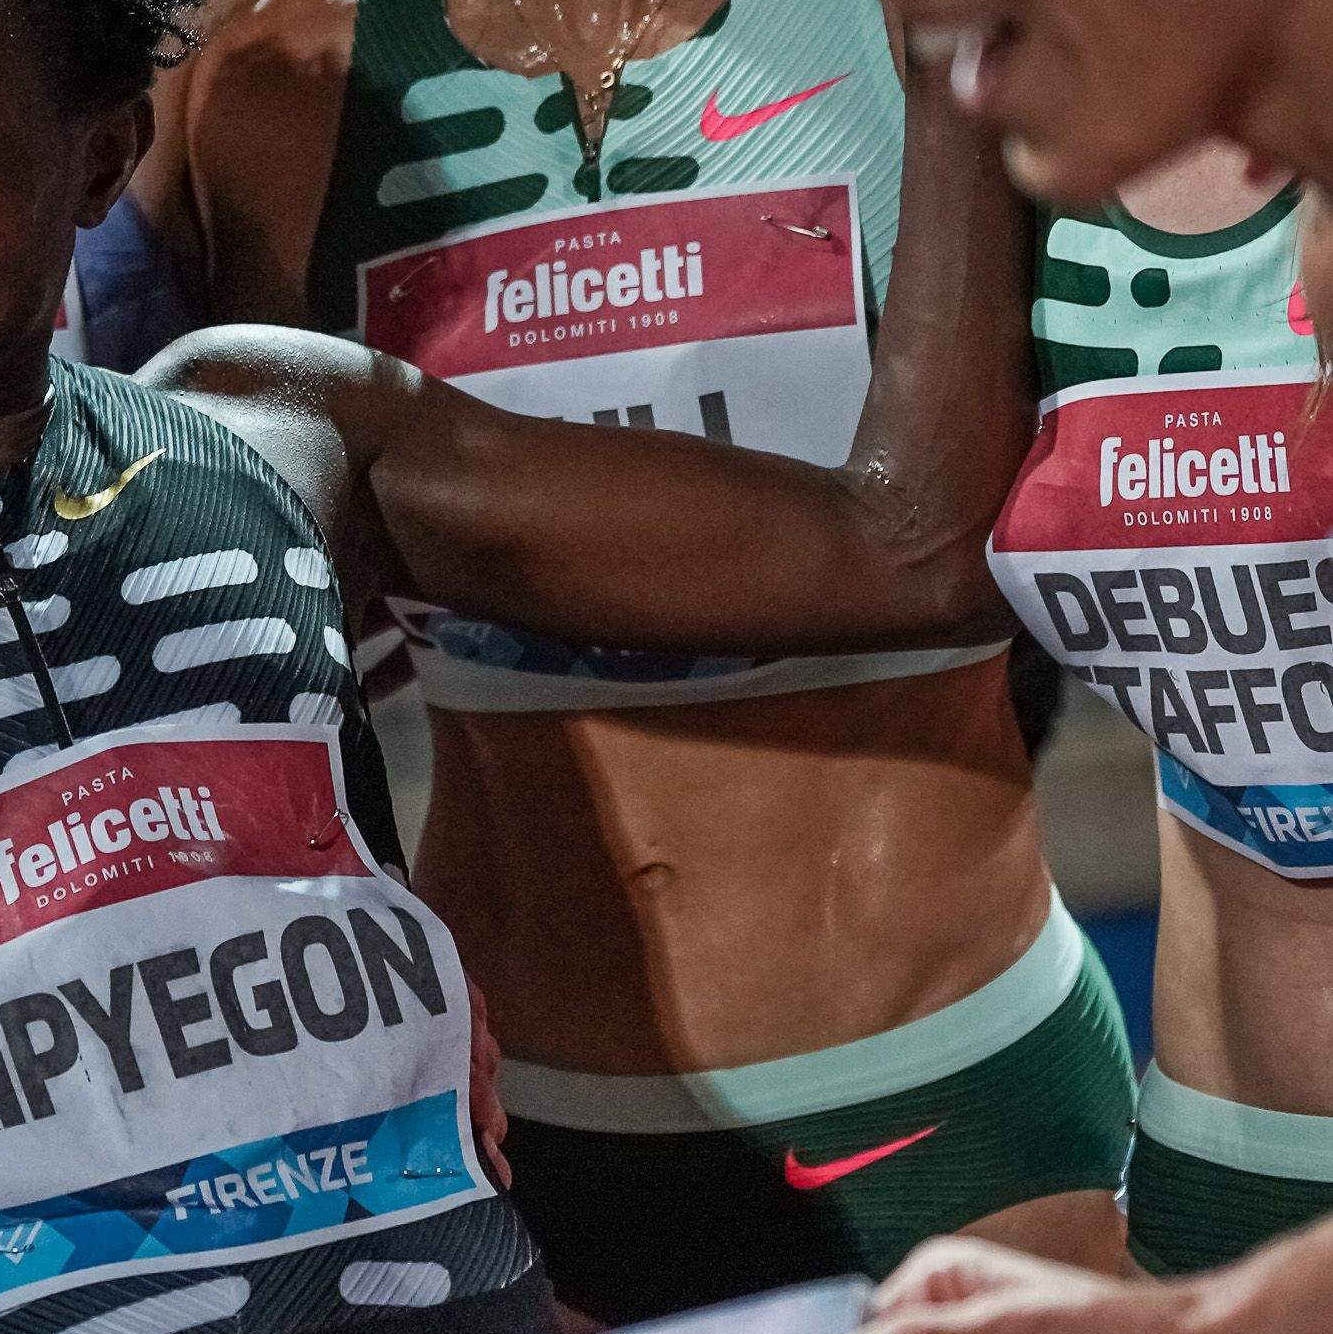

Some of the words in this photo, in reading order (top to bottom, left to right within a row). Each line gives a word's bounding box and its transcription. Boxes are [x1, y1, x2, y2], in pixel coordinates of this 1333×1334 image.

[554, 231, 622, 253] PASTA
[484, 241, 704, 333] felicetti
[509, 319, 616, 347] DOLOMITI
[629, 310, 679, 329] 1908
[1165, 412, 1222, 428] PASTA
[1100, 432, 1291, 507] felicetti
[1123, 509, 1218, 526] DOLOMITI
[1230, 506, 1272, 524] 1908
[1034, 557, 1333, 656] DEBUE
[1069, 661, 1333, 755] TAFFO
[61, 767, 134, 806] PASTA
[36, 855, 155, 908] DOLOMITI
[168, 850, 214, 864] 1908
[166, 1140, 374, 1221] FIRENZE
